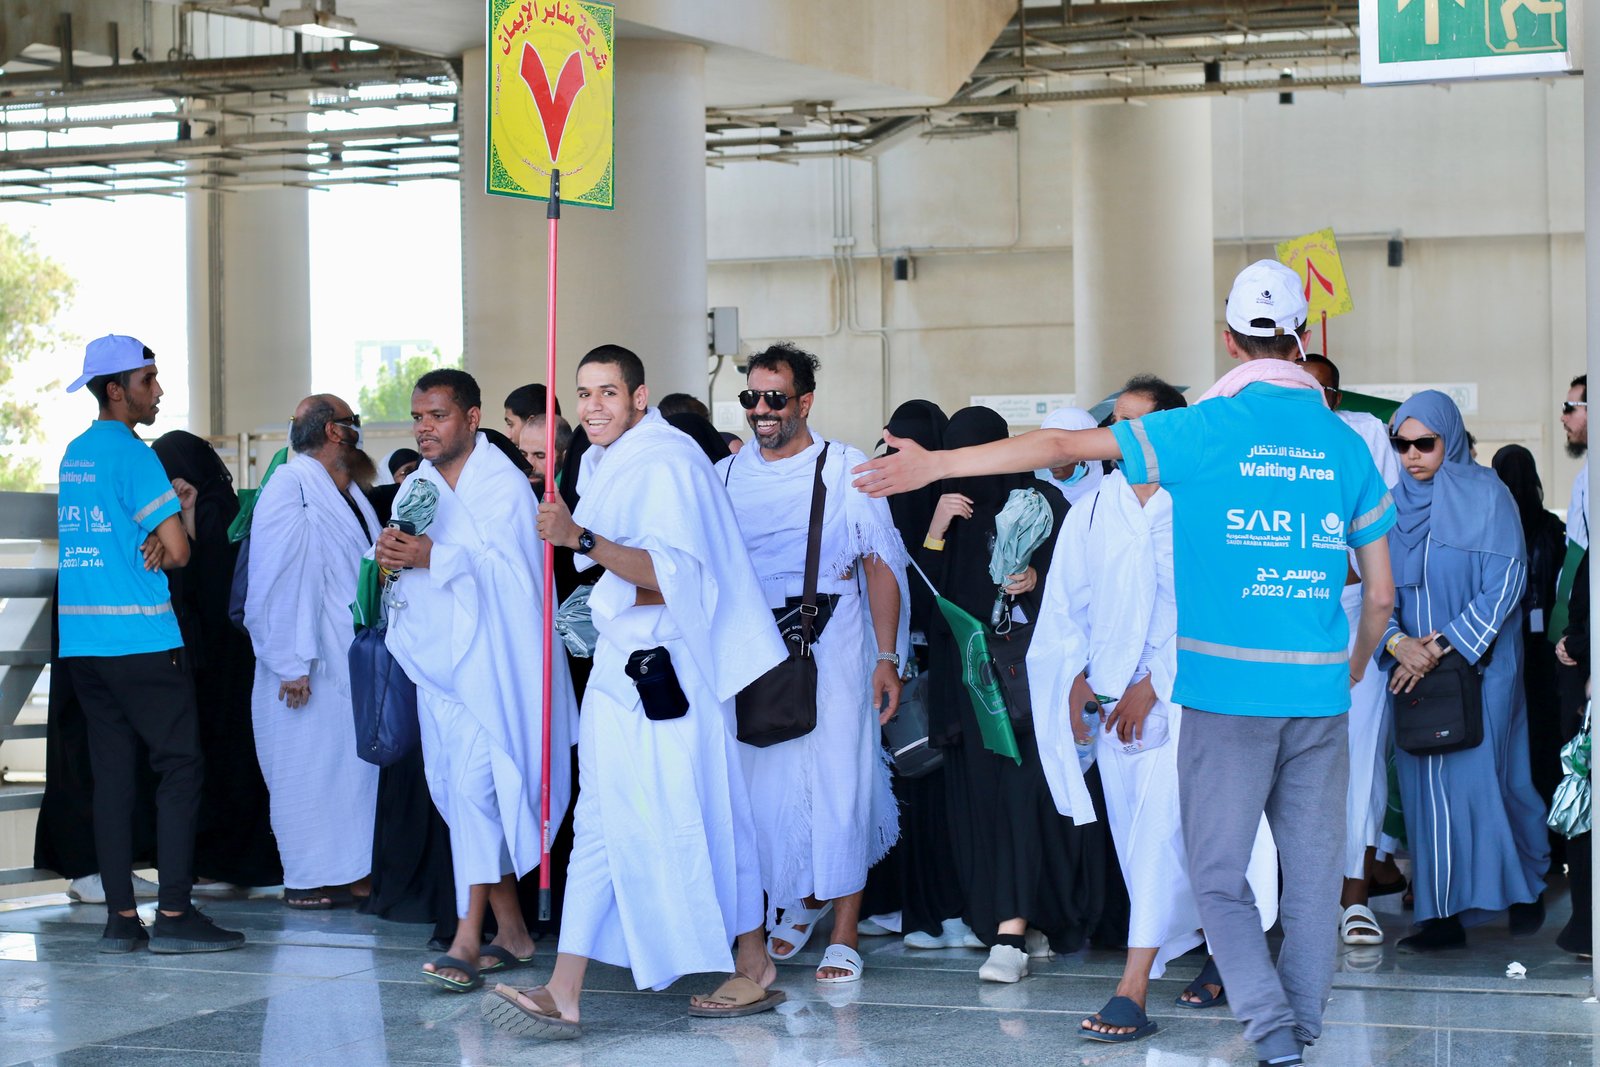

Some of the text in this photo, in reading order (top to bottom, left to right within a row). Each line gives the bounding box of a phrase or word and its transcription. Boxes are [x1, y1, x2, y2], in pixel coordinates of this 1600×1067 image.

[541, 0, 575, 27] منابر
[576, 13, 608, 71] شركة
[519, 41, 585, 164] ٧
[1246, 444, 1326, 460] منطقة الانتظار
[1239, 461, 1335, 481] Waiting Area
[1226, 508, 1293, 532] SAR
[1257, 567, 1327, 583] موسم حج
